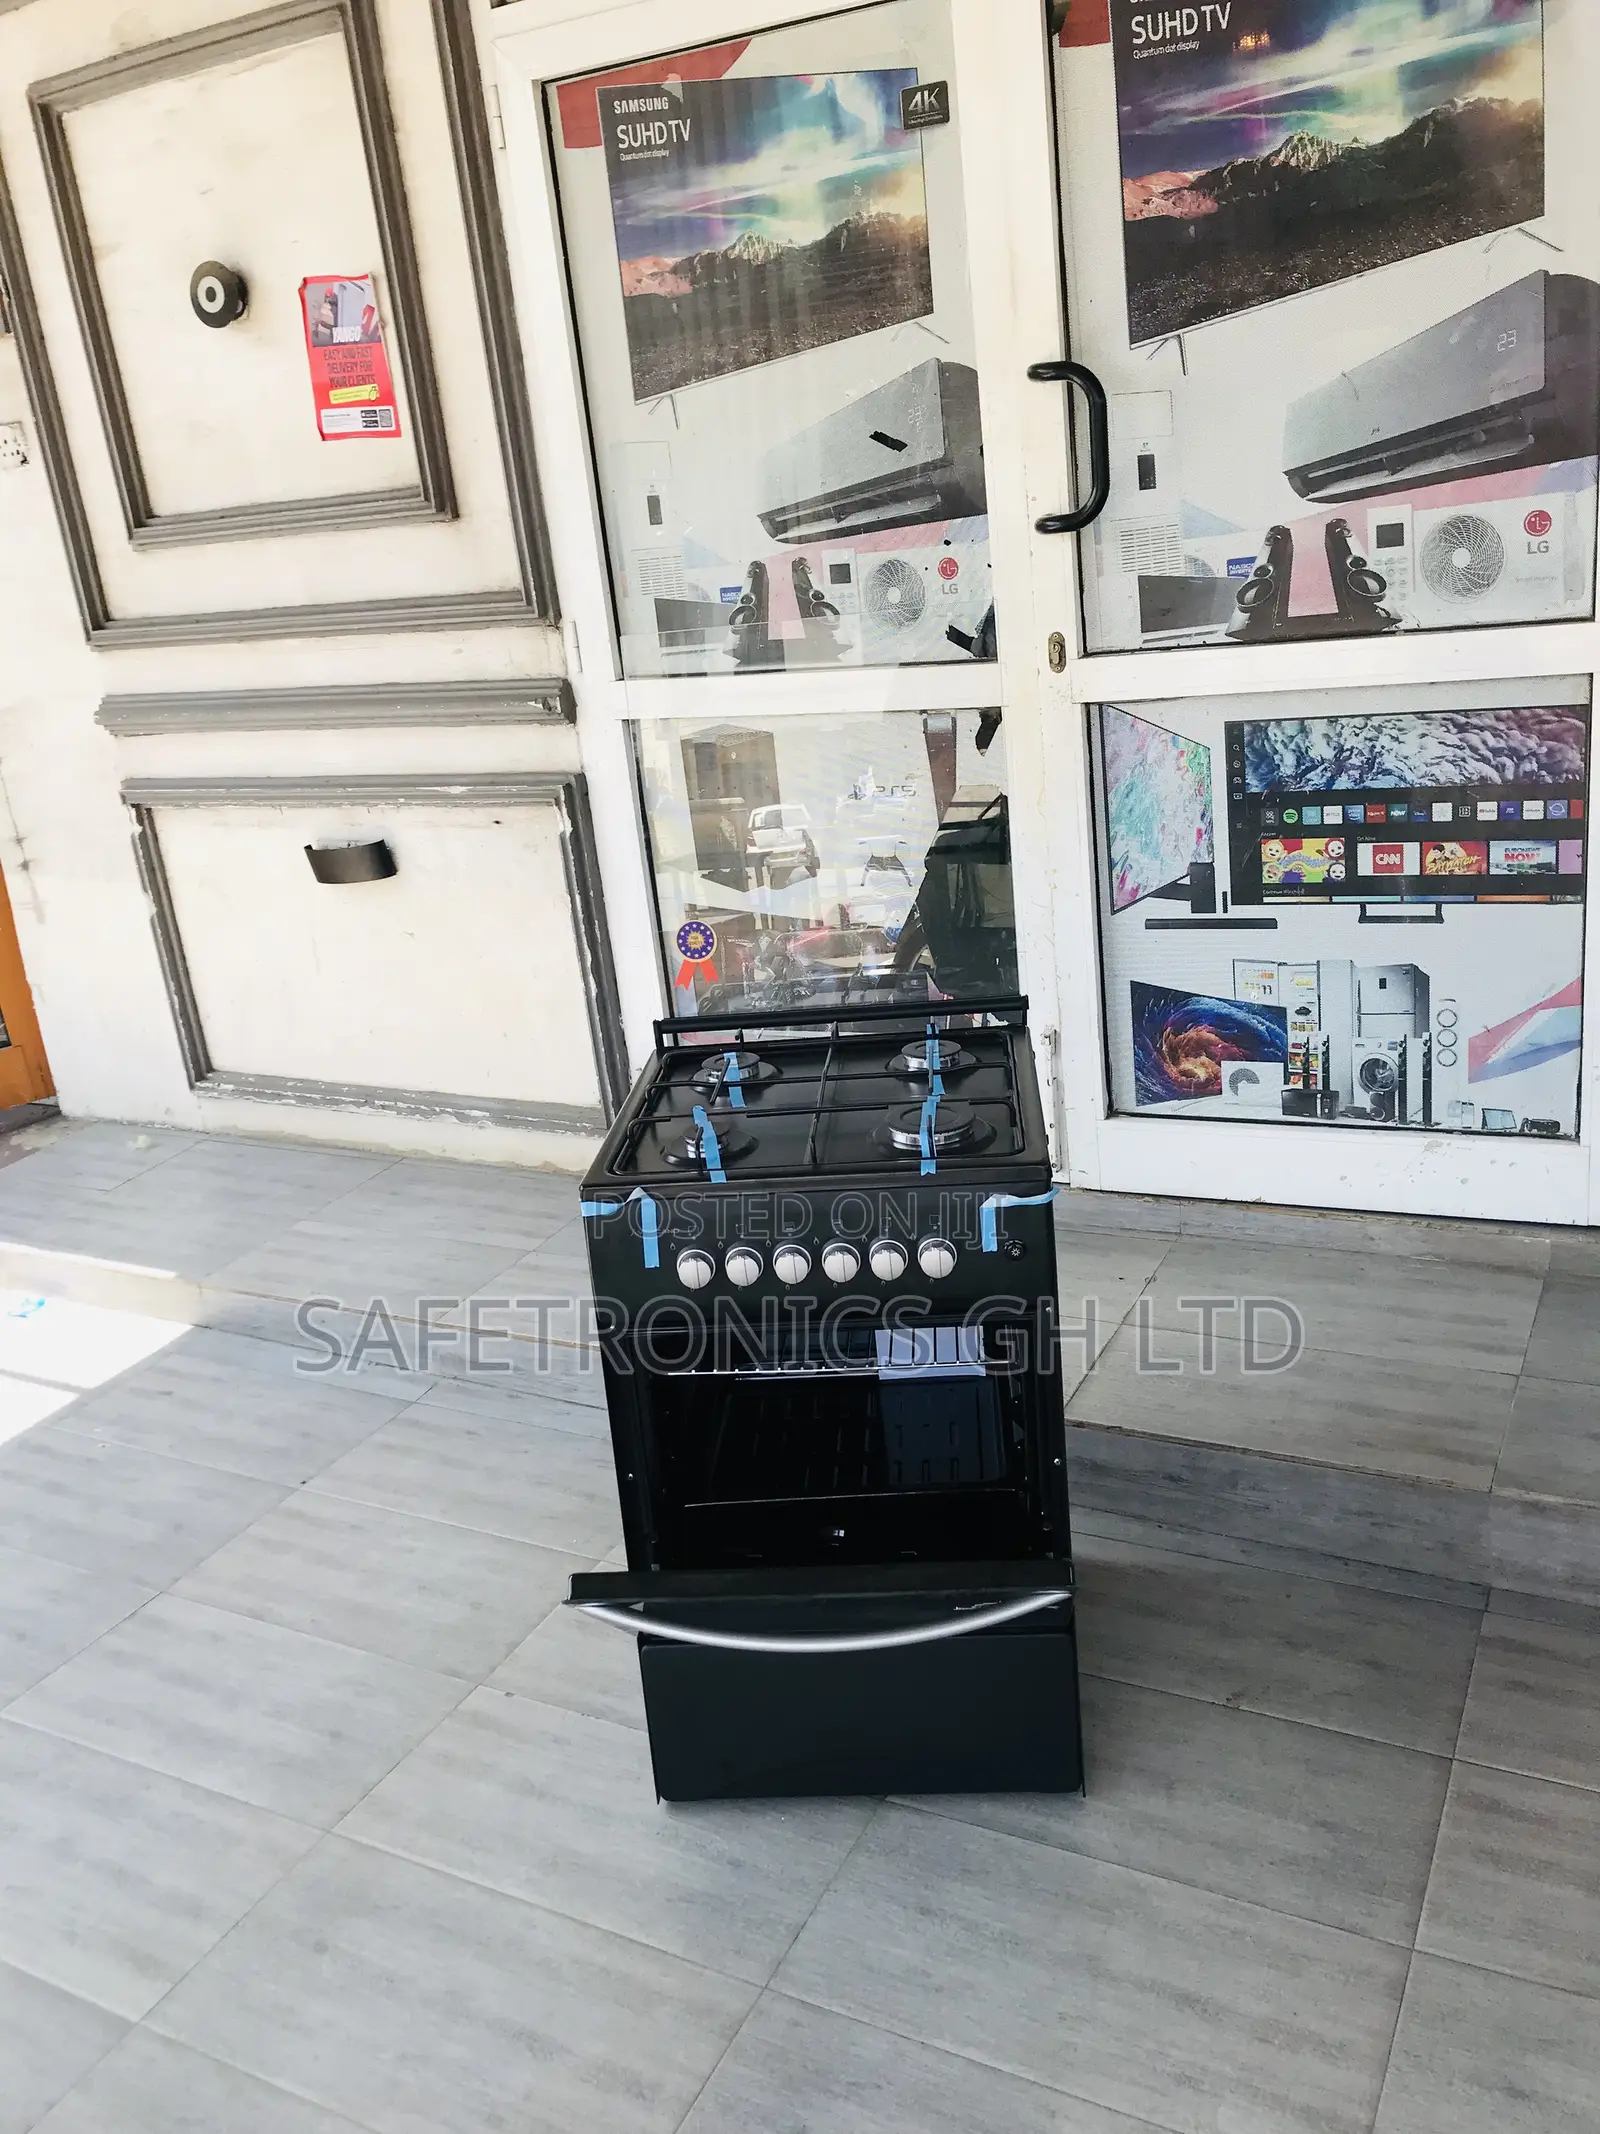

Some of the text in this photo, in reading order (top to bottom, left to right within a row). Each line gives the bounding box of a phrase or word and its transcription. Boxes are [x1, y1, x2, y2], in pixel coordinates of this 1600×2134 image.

[1131, 2, 1232, 44] SUHD TV
[1133, 40, 1200, 59] Quantum dot display
[613, 97, 669, 114] SAMSUNG
[908, 88, 940, 113] 4K
[617, 118, 691, 149] SUHD TV
[332, 326, 362, 343] YANGO
[324, 346, 373, 361] EASY AND FAST
[327, 361, 373, 374] DELIVERY FOR
[328, 374, 376, 388] YOUR CLIENTS
[1527, 540, 1549, 555] LG
[941, 583, 959, 595] LG
[1374, 853, 1402, 865] CNN
